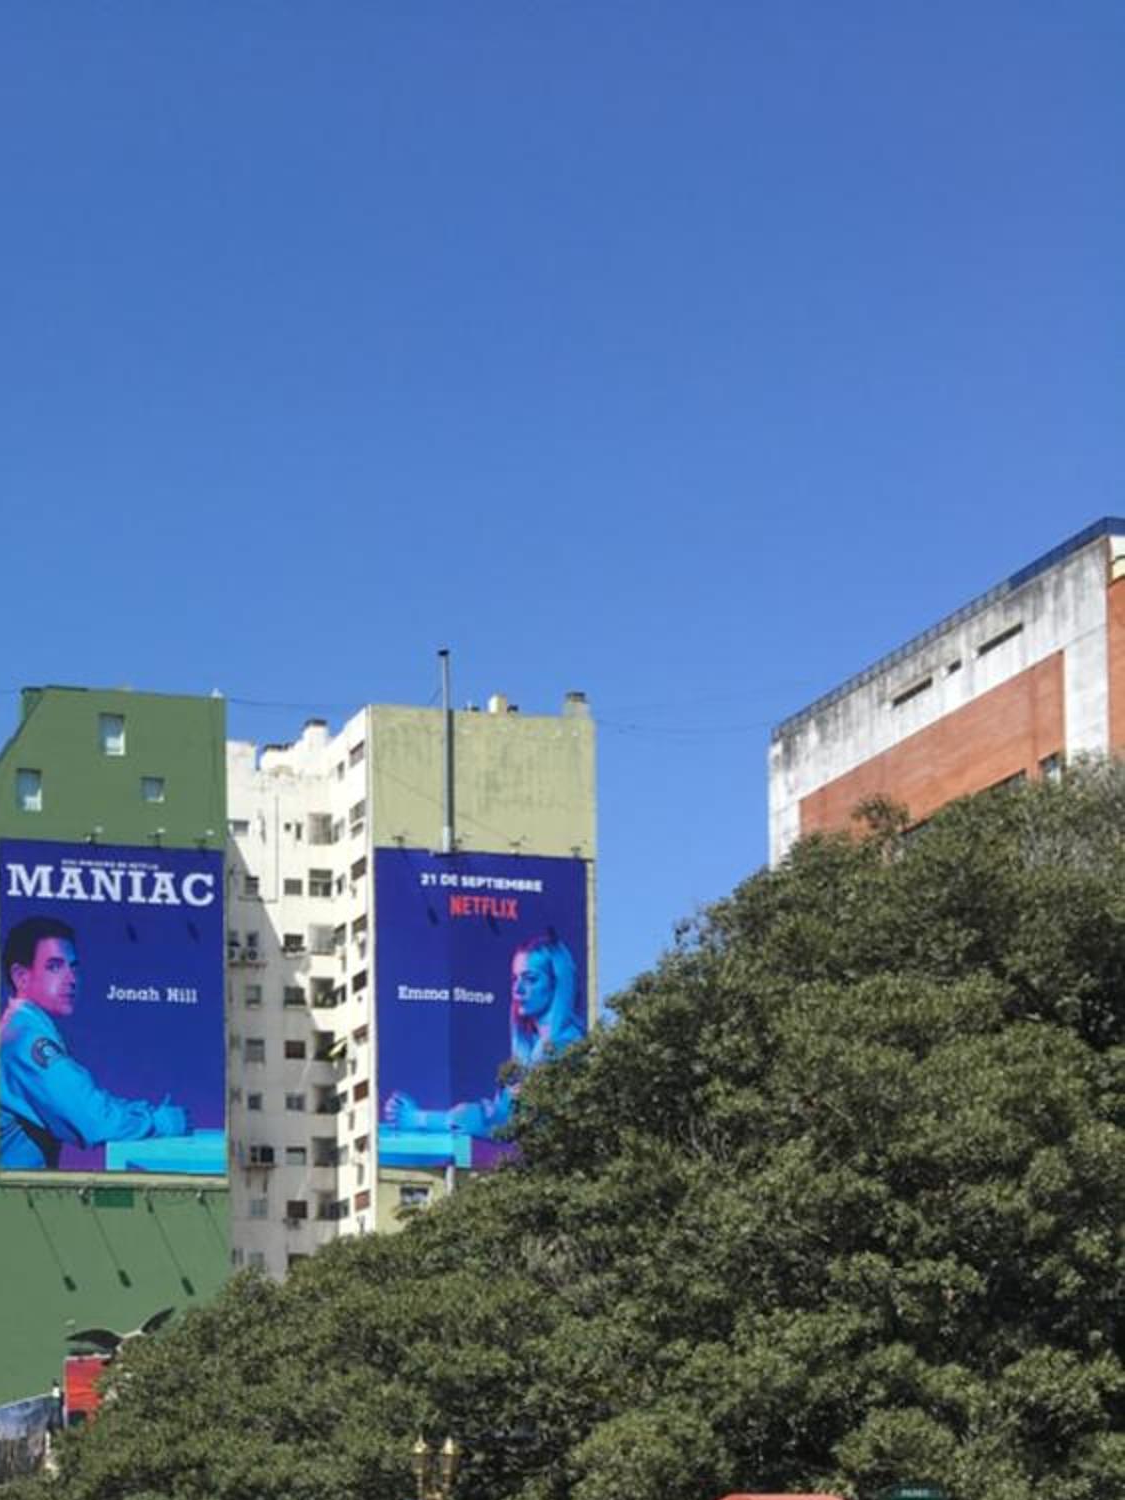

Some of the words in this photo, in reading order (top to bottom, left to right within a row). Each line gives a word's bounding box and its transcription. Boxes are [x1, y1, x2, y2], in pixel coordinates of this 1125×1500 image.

[6, 863, 215, 907] MANIAC
[420, 873, 437, 887] 21
[440, 874, 458, 887] DE
[461, 875, 543, 893] SEPTIEMBRE
[450, 895, 518, 920] NETFLIX
[106, 984, 160, 1002] Jonah
[167, 987, 198, 1004] Hill
[397, 985, 450, 1001] Emma
